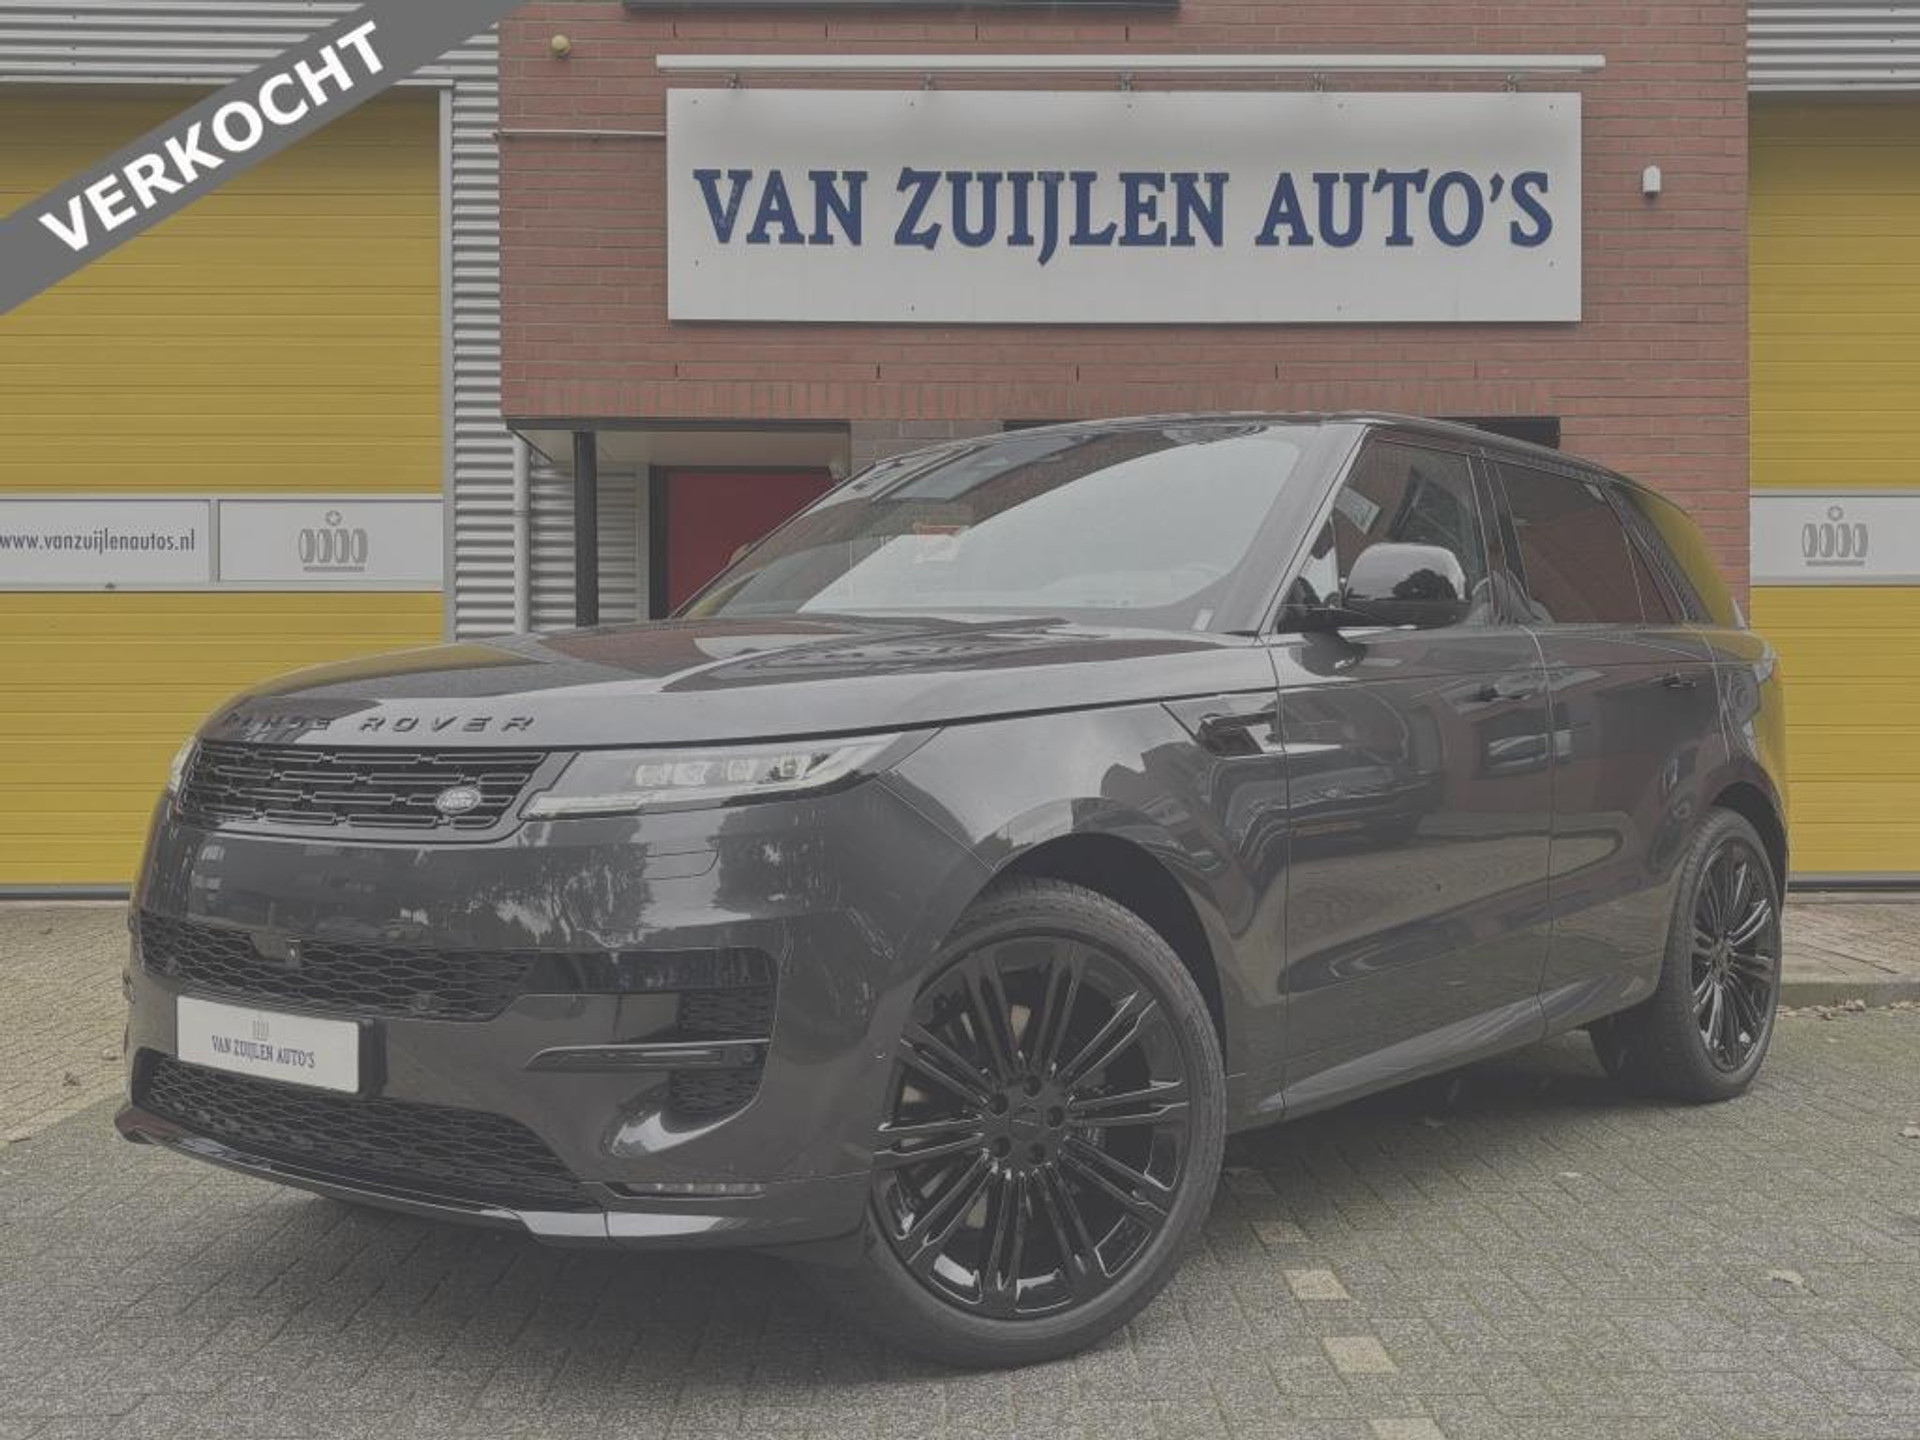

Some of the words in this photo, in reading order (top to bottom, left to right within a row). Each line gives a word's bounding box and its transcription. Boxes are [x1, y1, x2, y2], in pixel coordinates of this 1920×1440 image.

[693, 169, 868, 246] VAN
[894, 166, 1230, 266] ZUIJLEN
[1254, 168, 1553, 248] AUTO'S
[0, 527, 195, 555] www.vanzuijlenautos.nl
[359, 716, 535, 732] ROVER
[211, 1034, 232, 1054] VAN
[276, 1047, 316, 1069] AUTO'S
